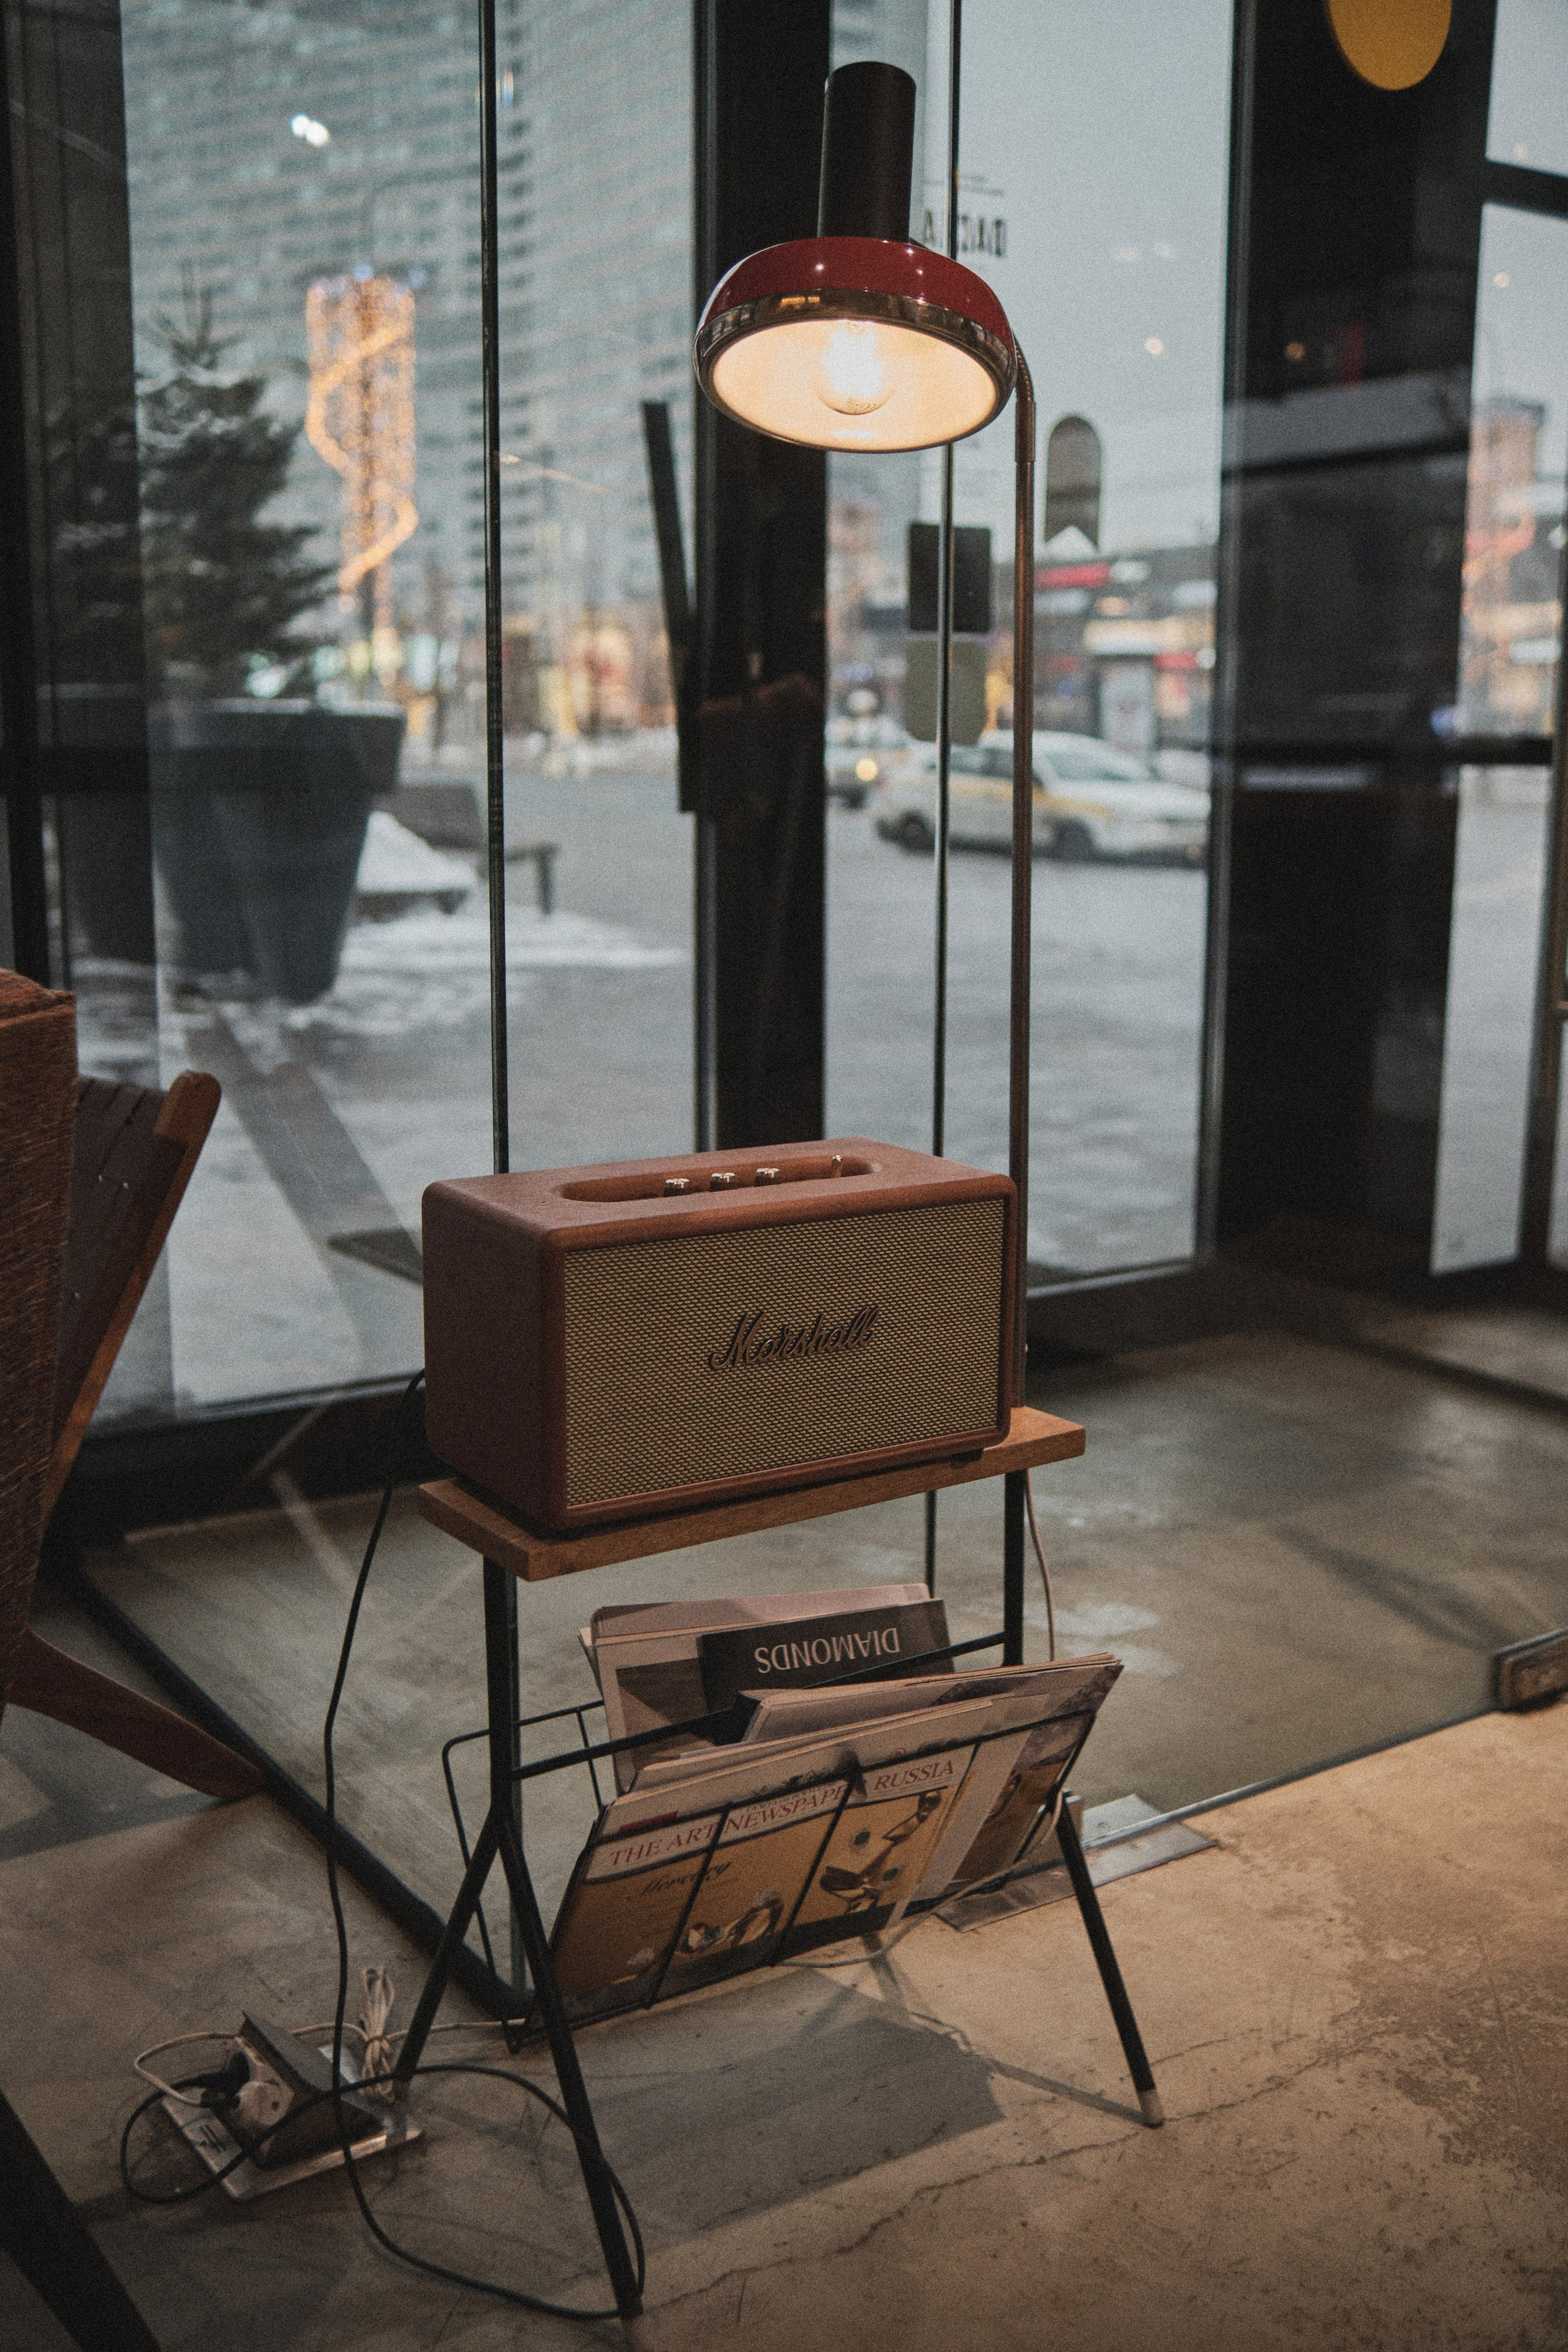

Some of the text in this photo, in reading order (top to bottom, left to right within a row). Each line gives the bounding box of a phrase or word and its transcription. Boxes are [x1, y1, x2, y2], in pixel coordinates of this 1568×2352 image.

[710, 1305, 881, 1370] Marshall
[754, 1627, 900, 1674] DIAMONDS
[611, 1839, 663, 1866] THE
[666, 1821, 720, 1851] ART
[873, 1759, 954, 1791] RUSSIA
